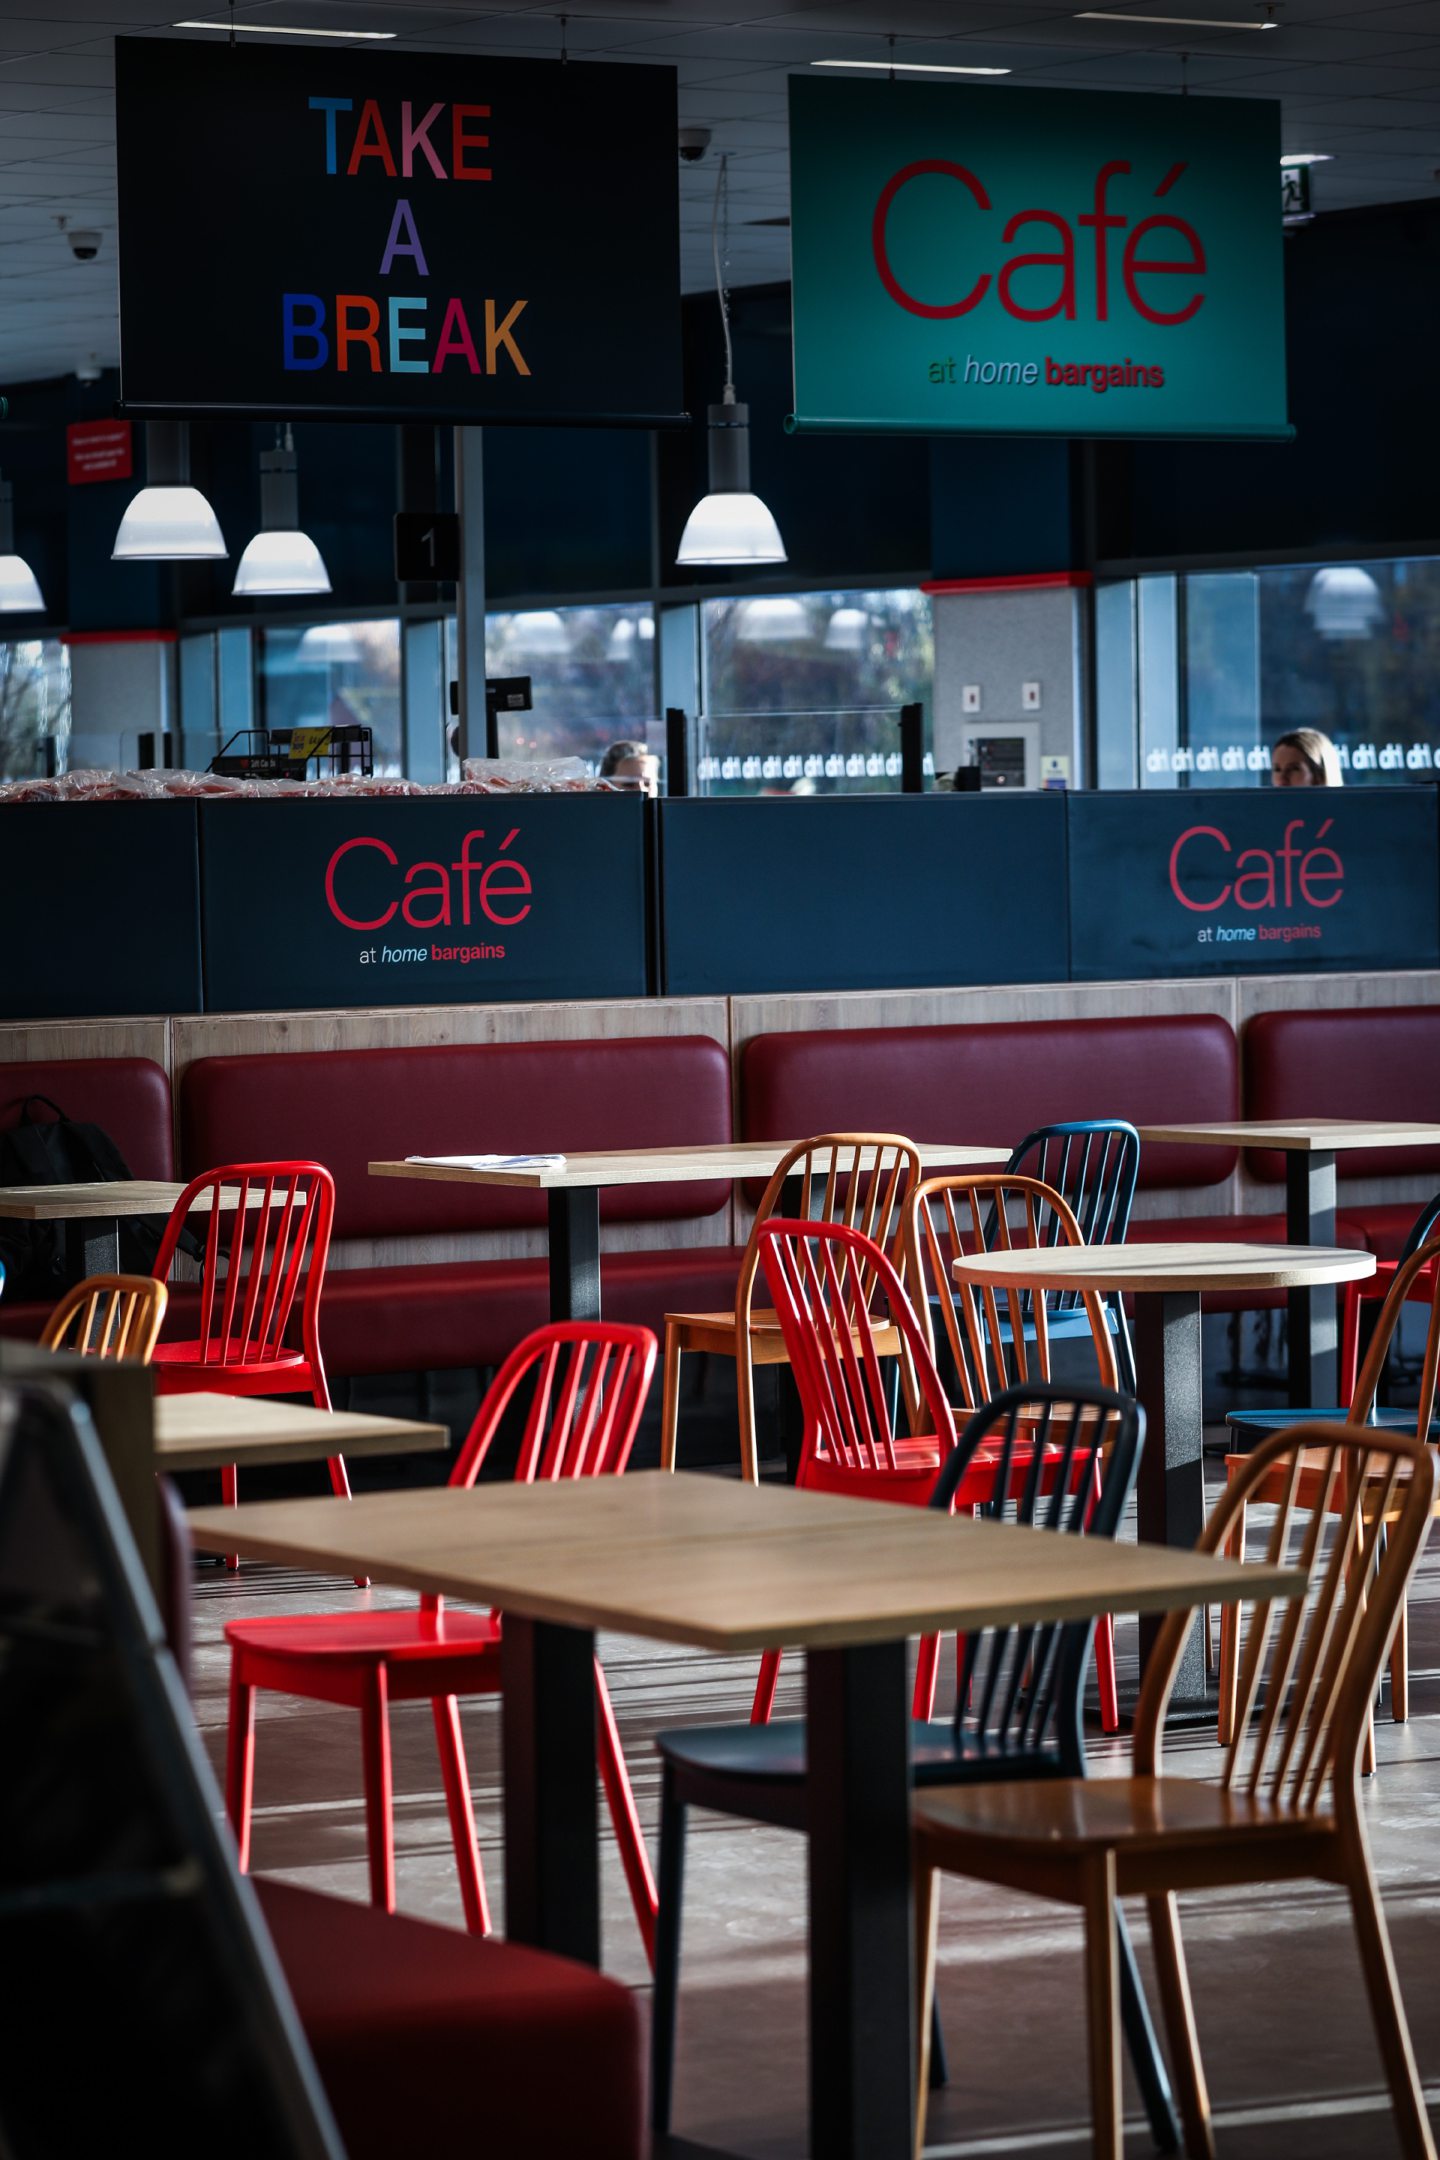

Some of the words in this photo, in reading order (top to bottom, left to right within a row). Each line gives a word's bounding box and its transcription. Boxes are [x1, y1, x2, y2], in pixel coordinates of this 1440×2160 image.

[309, 97, 492, 181] TAKE
[379, 199, 429, 276] A
[872, 159, 1206, 326] Café
[282, 294, 531, 376] BREAK
[928, 357, 956, 384] at
[964, 354, 1039, 385] home
[1045, 356, 1165, 393] bargains
[421, 527, 435, 567] 1
[325, 828, 532, 931] Café
[1169, 819, 1345, 912] Café
[360, 947, 377, 963] at
[382, 946, 428, 963] home
[431, 942, 506, 964] bargains
[1198, 926, 1213, 942] at
[1216, 926, 1257, 941] home
[1259, 924, 1322, 943] bargains
